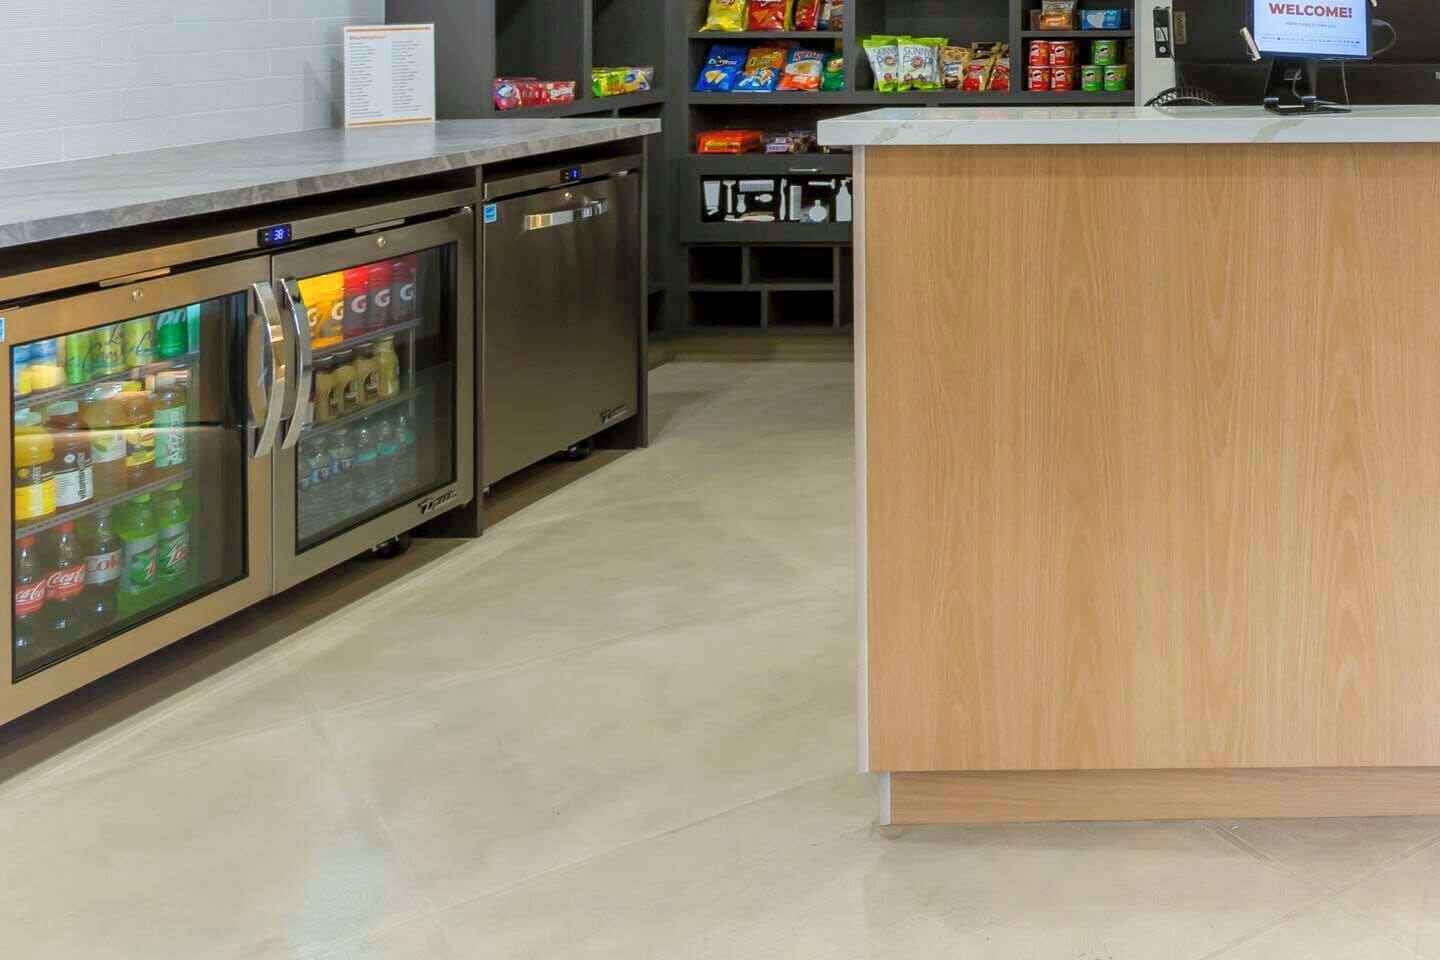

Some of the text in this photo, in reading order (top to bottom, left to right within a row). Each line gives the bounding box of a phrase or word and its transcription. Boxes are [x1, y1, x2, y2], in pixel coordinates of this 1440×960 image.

[1268, 2, 1352, 19] WELCOME!
[273, 228, 285, 241] 38
[375, 288, 391, 308] G
[400, 283, 414, 301] G
[331, 301, 345, 321] G
[351, 294, 367, 313] G
